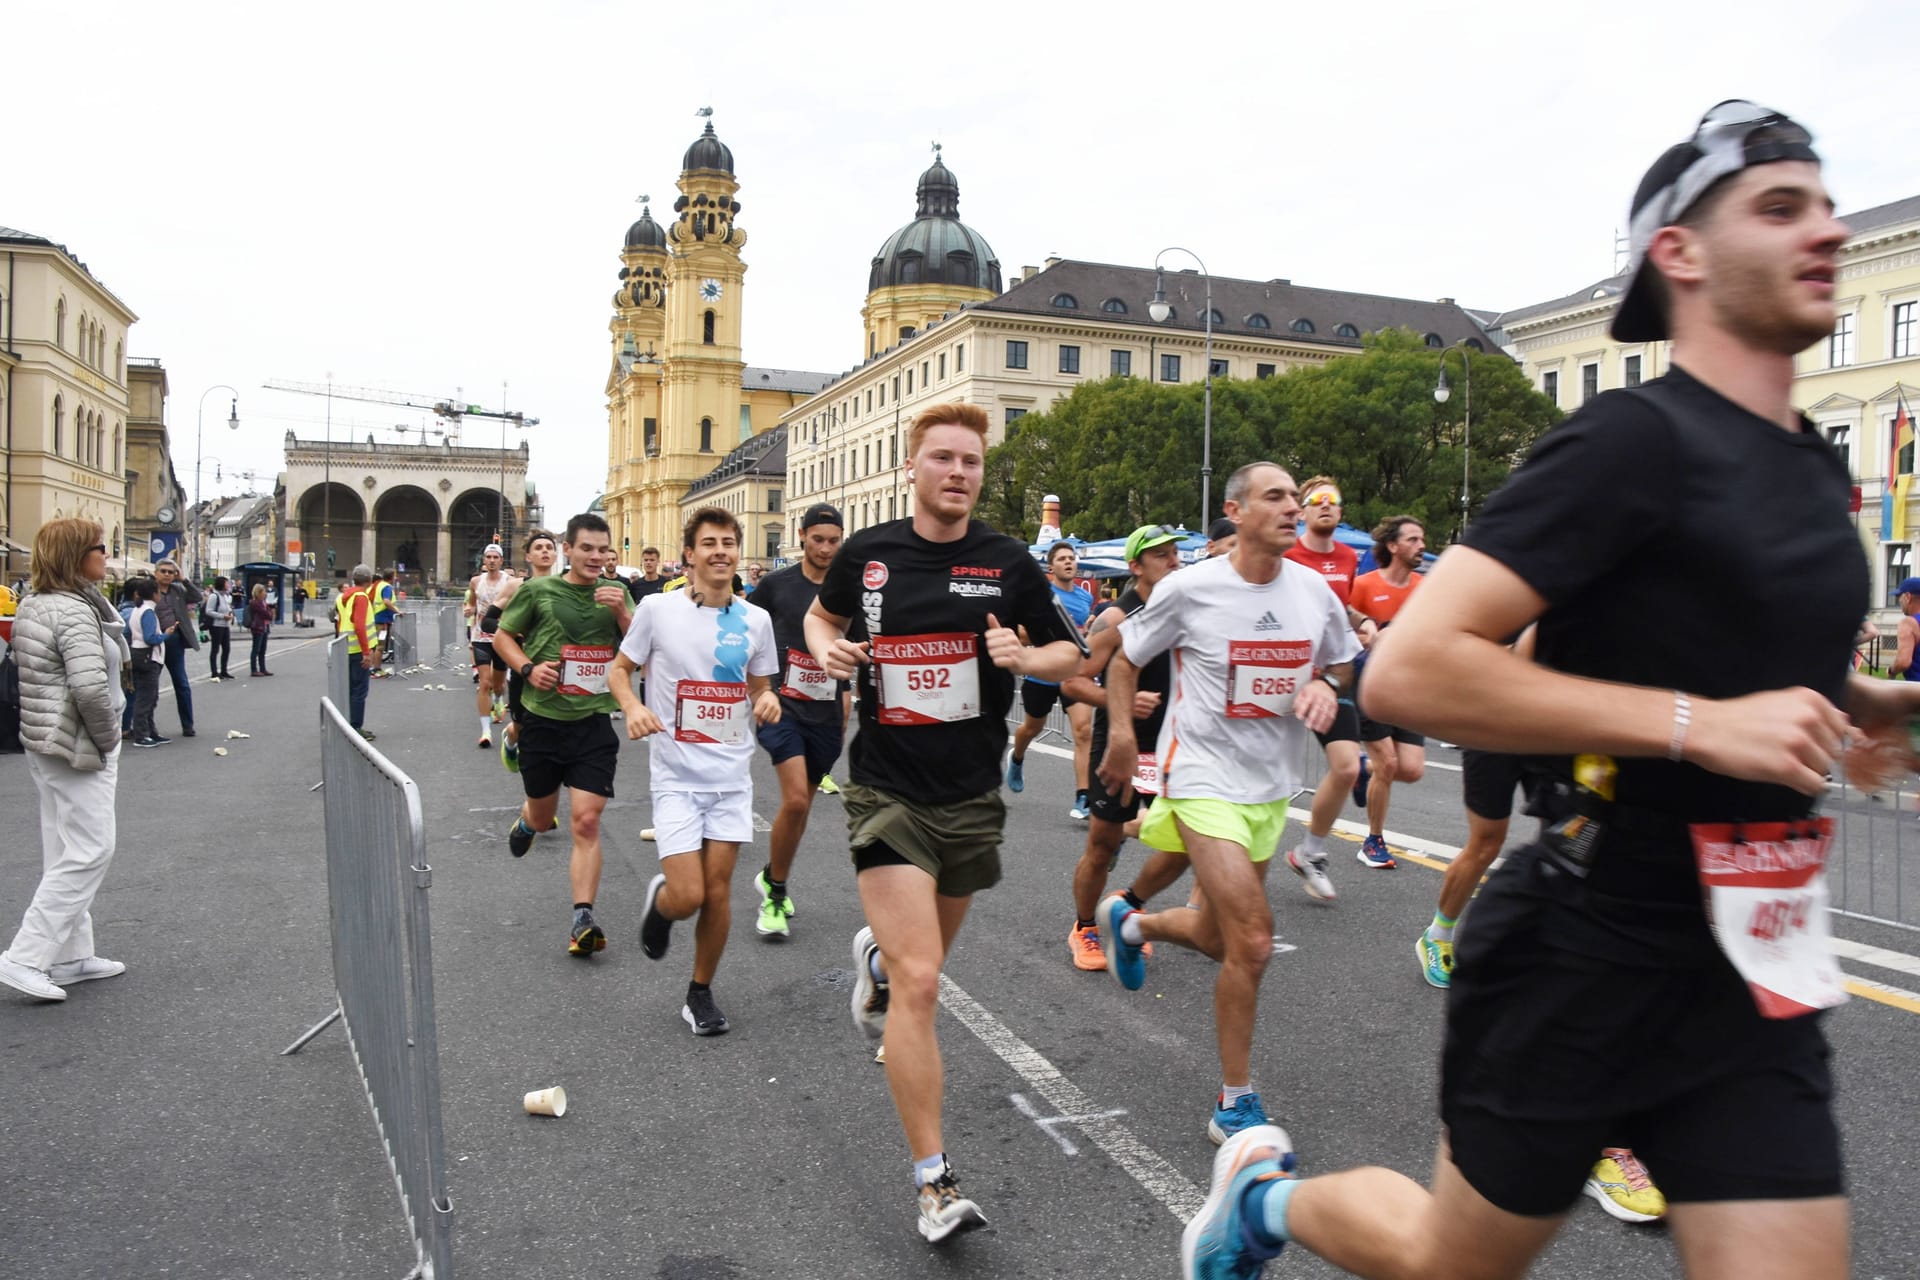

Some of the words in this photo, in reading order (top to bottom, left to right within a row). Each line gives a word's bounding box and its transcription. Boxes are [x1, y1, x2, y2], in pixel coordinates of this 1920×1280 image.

[950, 566, 1002, 577] SPRINT
[949, 582, 1002, 597] Rakuten
[893, 640, 973, 658] GENERALI
[576, 664, 606, 676] 3840
[799, 671, 827, 683] 3656
[907, 668, 951, 690] 592
[1252, 677, 1296, 695] 6265
[695, 686, 746, 697] GENERALI
[696, 705, 732, 720] 3491
